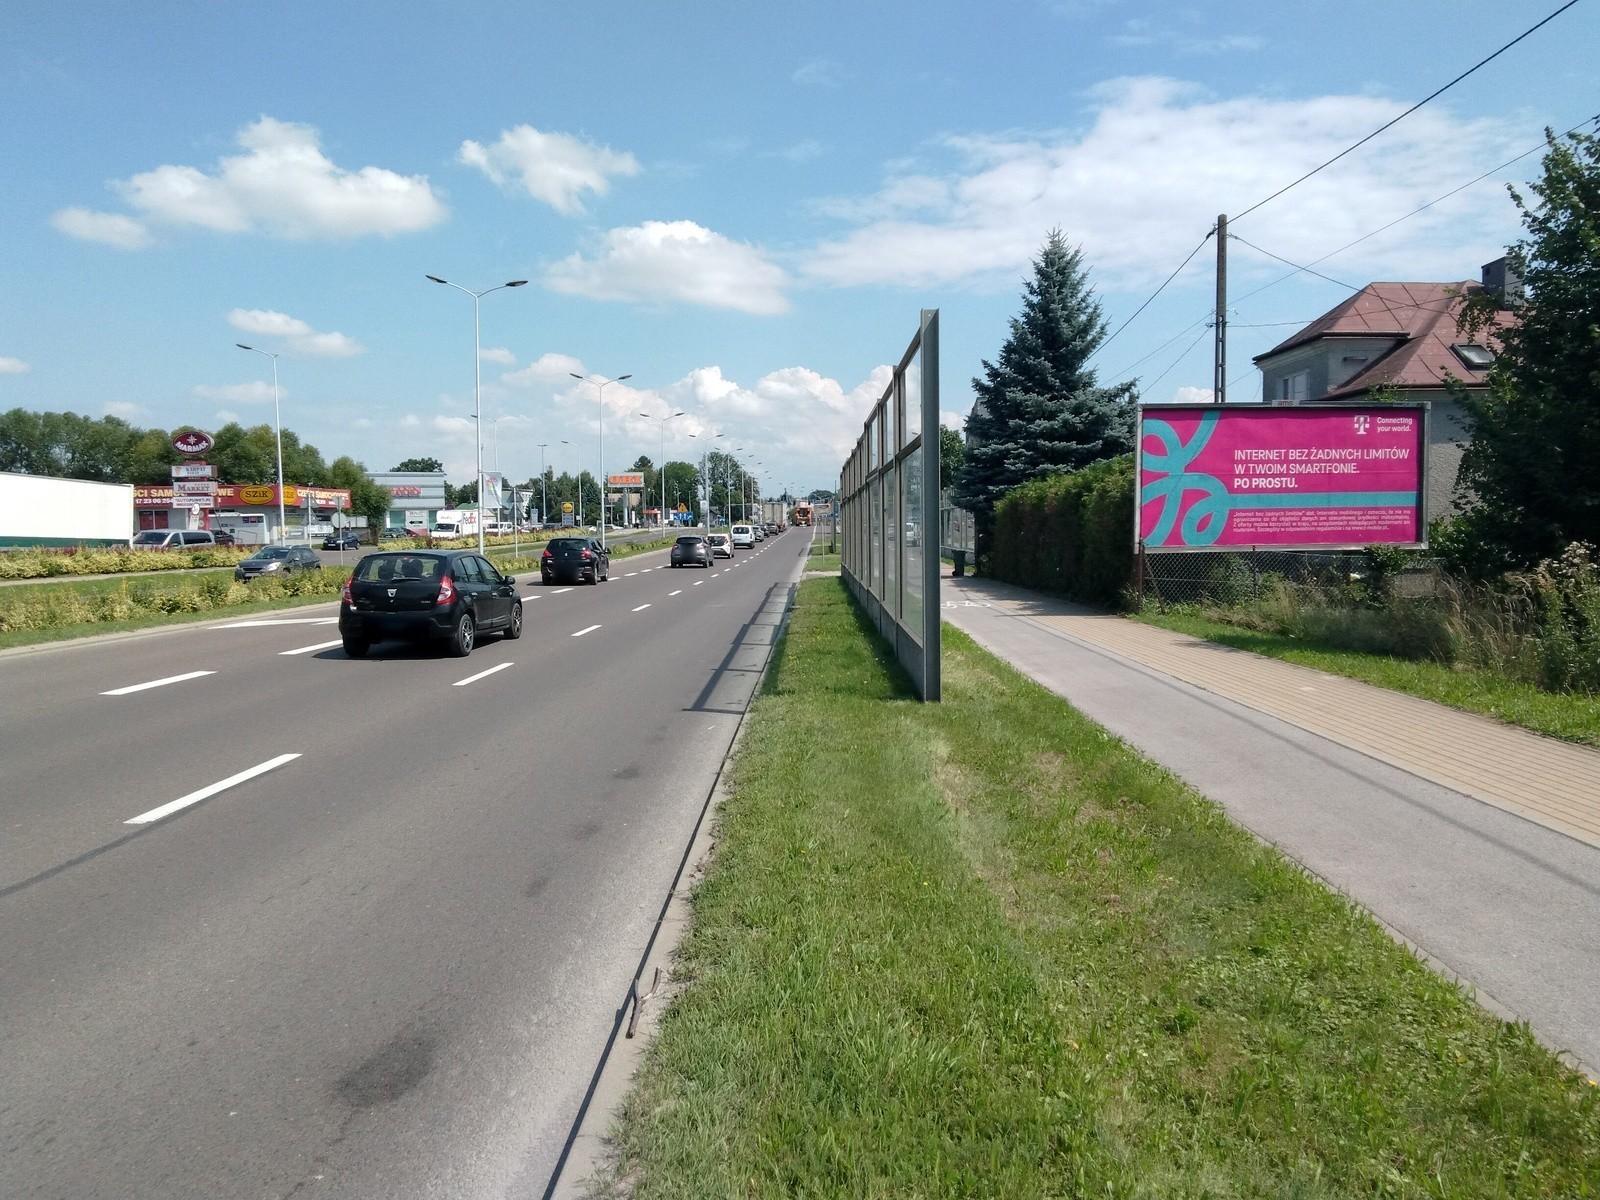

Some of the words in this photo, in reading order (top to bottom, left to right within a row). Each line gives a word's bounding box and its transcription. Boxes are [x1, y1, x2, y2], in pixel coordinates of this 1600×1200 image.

[1377, 417, 1413, 425] Connecting
[175, 441, 209, 452] MARMAX
[1234, 449, 1287, 460] INTERNET
[1288, 449, 1309, 460] BEZ
[1310, 446, 1362, 460] ŻADNYCH
[1364, 446, 1410, 460] LIMITÓW
[1234, 463, 1246, 474] W
[1248, 463, 1287, 474] TWOIM
[1289, 462, 1360, 474] SMARTFONIE.
[1234, 478, 1250, 489] PO
[1252, 477, 1298, 488] PROSTU.
